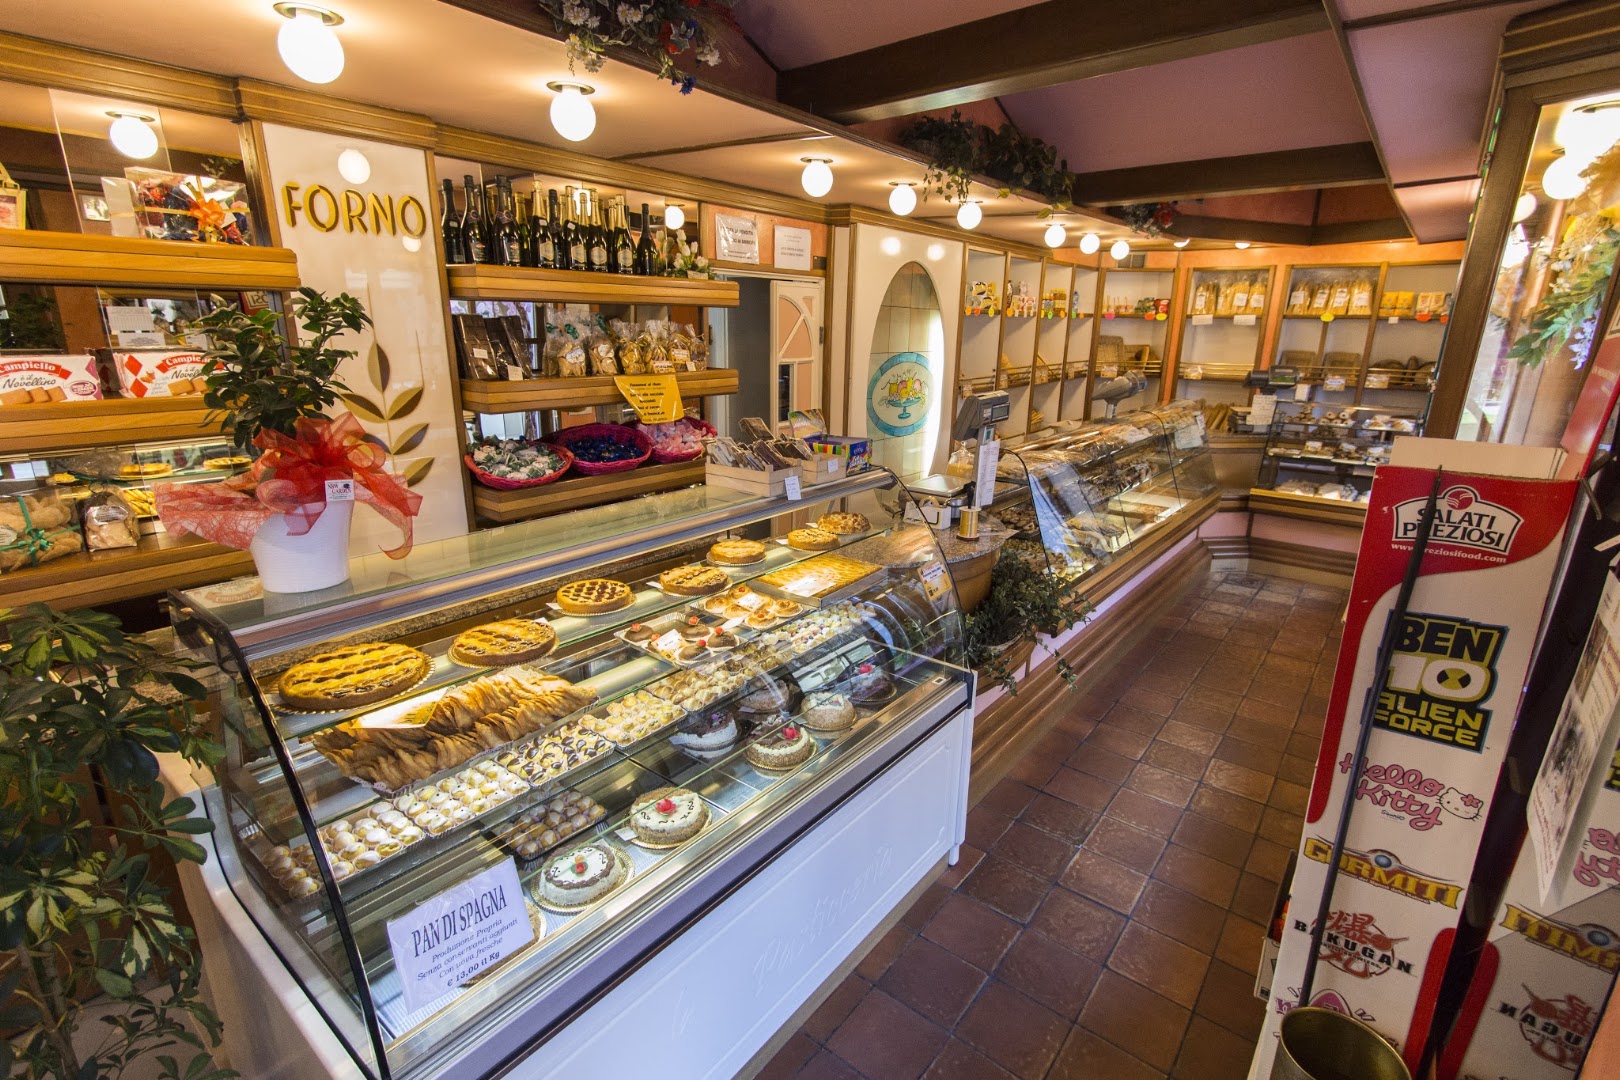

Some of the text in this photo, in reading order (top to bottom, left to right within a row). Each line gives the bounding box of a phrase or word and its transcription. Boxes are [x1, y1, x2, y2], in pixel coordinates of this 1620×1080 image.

[281, 181, 427, 240] FORNO
[166, 354, 211, 366] Campie
[3, 375, 57, 390] Novellino
[1391, 543, 1507, 563] wwwreziosifood.com
[1402, 522, 1505, 548] PEZIOSI
[1394, 619, 1495, 663] BEN
[1390, 653, 1489, 700] 10
[1374, 709, 1479, 747] FORCE
[1379, 691, 1484, 731] ALIEN
[1339, 752, 1446, 798] Hello
[1356, 779, 1443, 831] Kitty
[411, 884, 508, 958] PAN DI SPAGNA
[432, 918, 502, 963] Produzione Propria
[417, 917, 518, 981] Senza conservanti aggiunti
[439, 937, 504, 979] Con uova fresche
[456, 962, 480, 983] 13,00
[489, 950, 500, 961] Kg
[1293, 919, 1415, 975] BKUGAN
